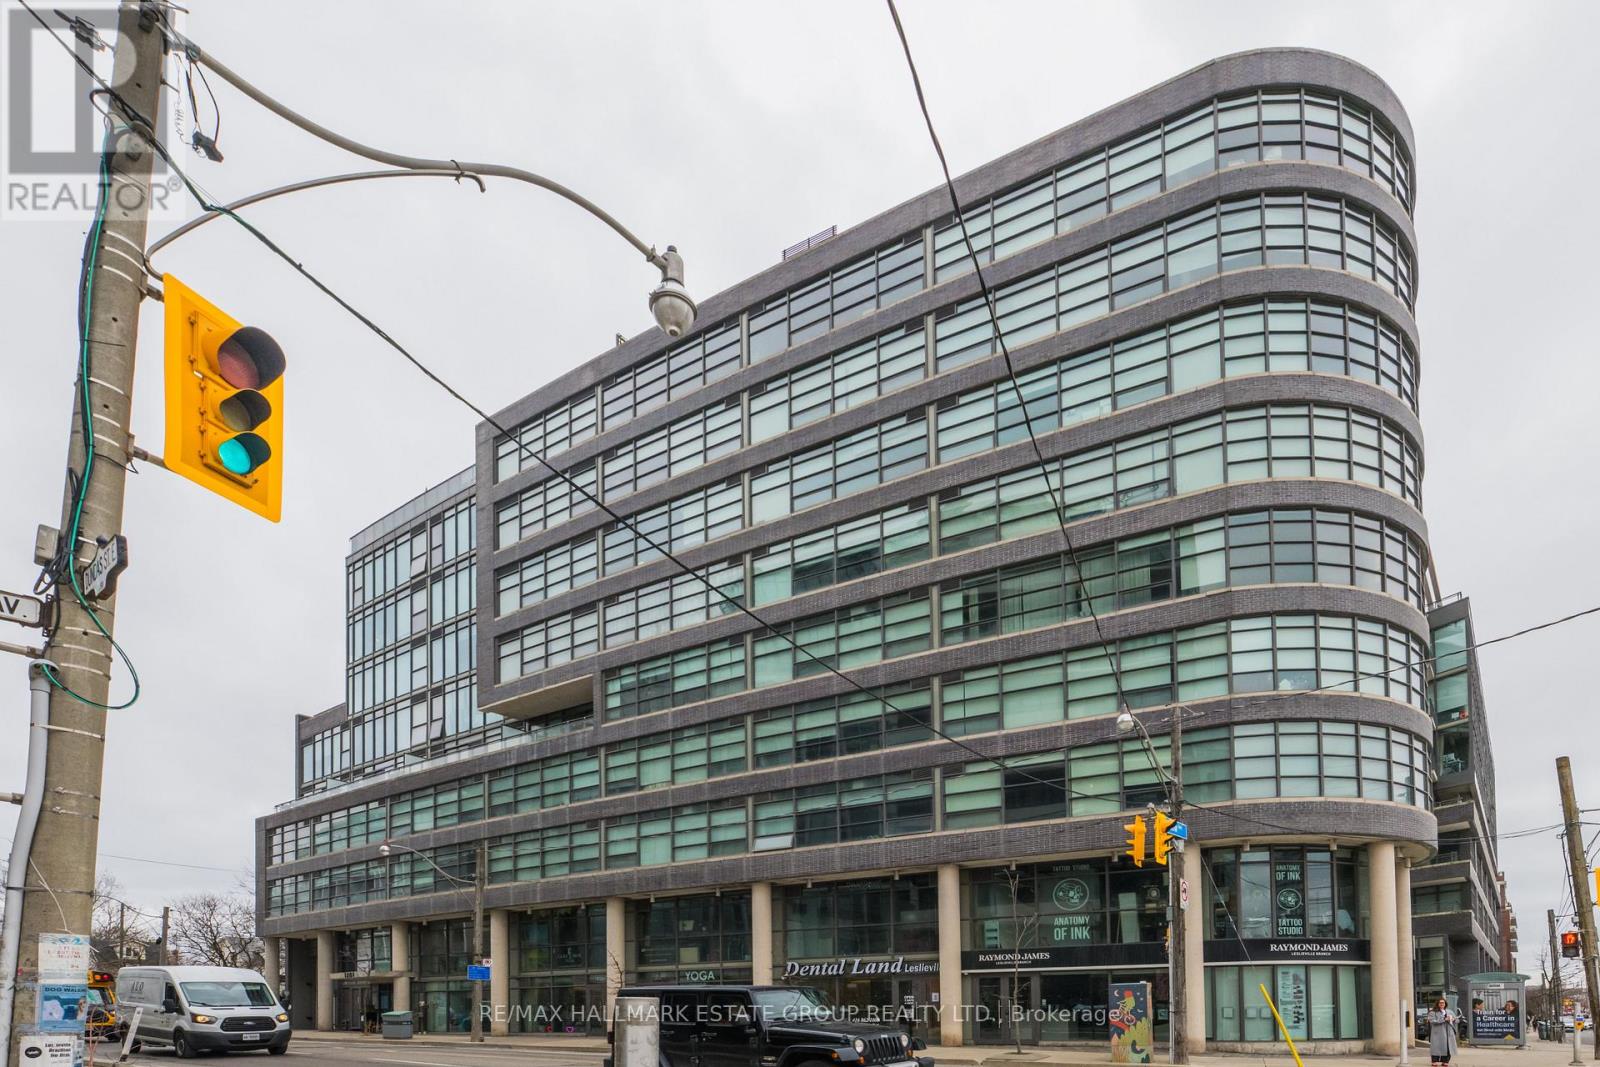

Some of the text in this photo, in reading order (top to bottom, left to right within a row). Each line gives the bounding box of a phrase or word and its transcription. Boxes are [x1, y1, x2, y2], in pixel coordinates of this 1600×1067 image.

[85, 555, 103, 591] DUNDAS
[1276, 871, 1301, 880] OF INK
[1054, 915, 1090, 926] ANATOMY
[1278, 918, 1303, 926] TATTOO
[1054, 926, 1090, 940] OF INK
[1278, 926, 1304, 935] STUDIO
[1270, 944, 1349, 952] RAYMOND JAMES
[979, 952, 1050, 962] RAYMOND JAMES
[784, 956, 939, 976] Dental Land Leslievil
[685, 970, 715, 981] YOGA
